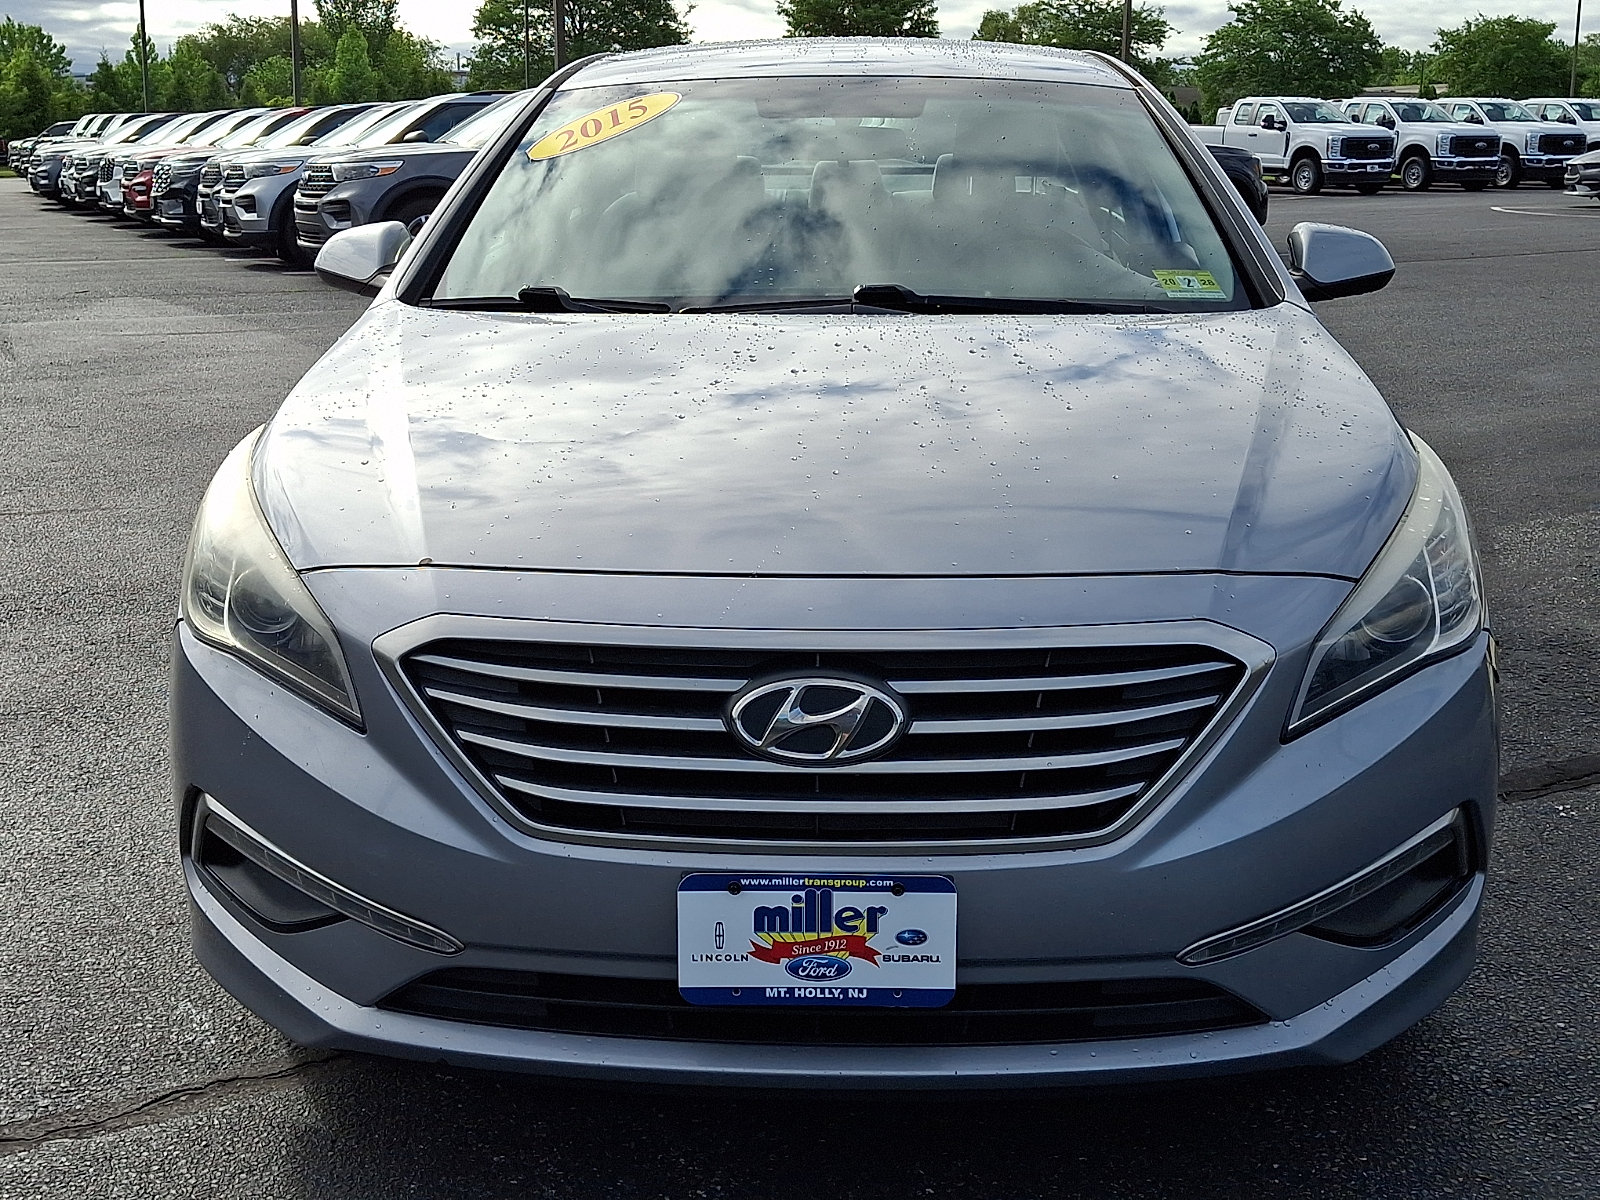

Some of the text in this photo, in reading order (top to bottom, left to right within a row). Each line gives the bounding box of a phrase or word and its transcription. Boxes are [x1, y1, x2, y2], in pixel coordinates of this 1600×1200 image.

[555, 99, 648, 152] 2015
[1184, 277, 1194, 288] 2
[740, 877, 894, 888] www.millertransgroup.com
[753, 888, 889, 934] miller
[791, 939, 847, 955] Since 1912
[691, 953, 750, 962] LINCOLN
[882, 954, 940, 963] SUBARU
[797, 959, 838, 978] Ford
[765, 988, 868, 1000] MT. HOLLY, NJ
